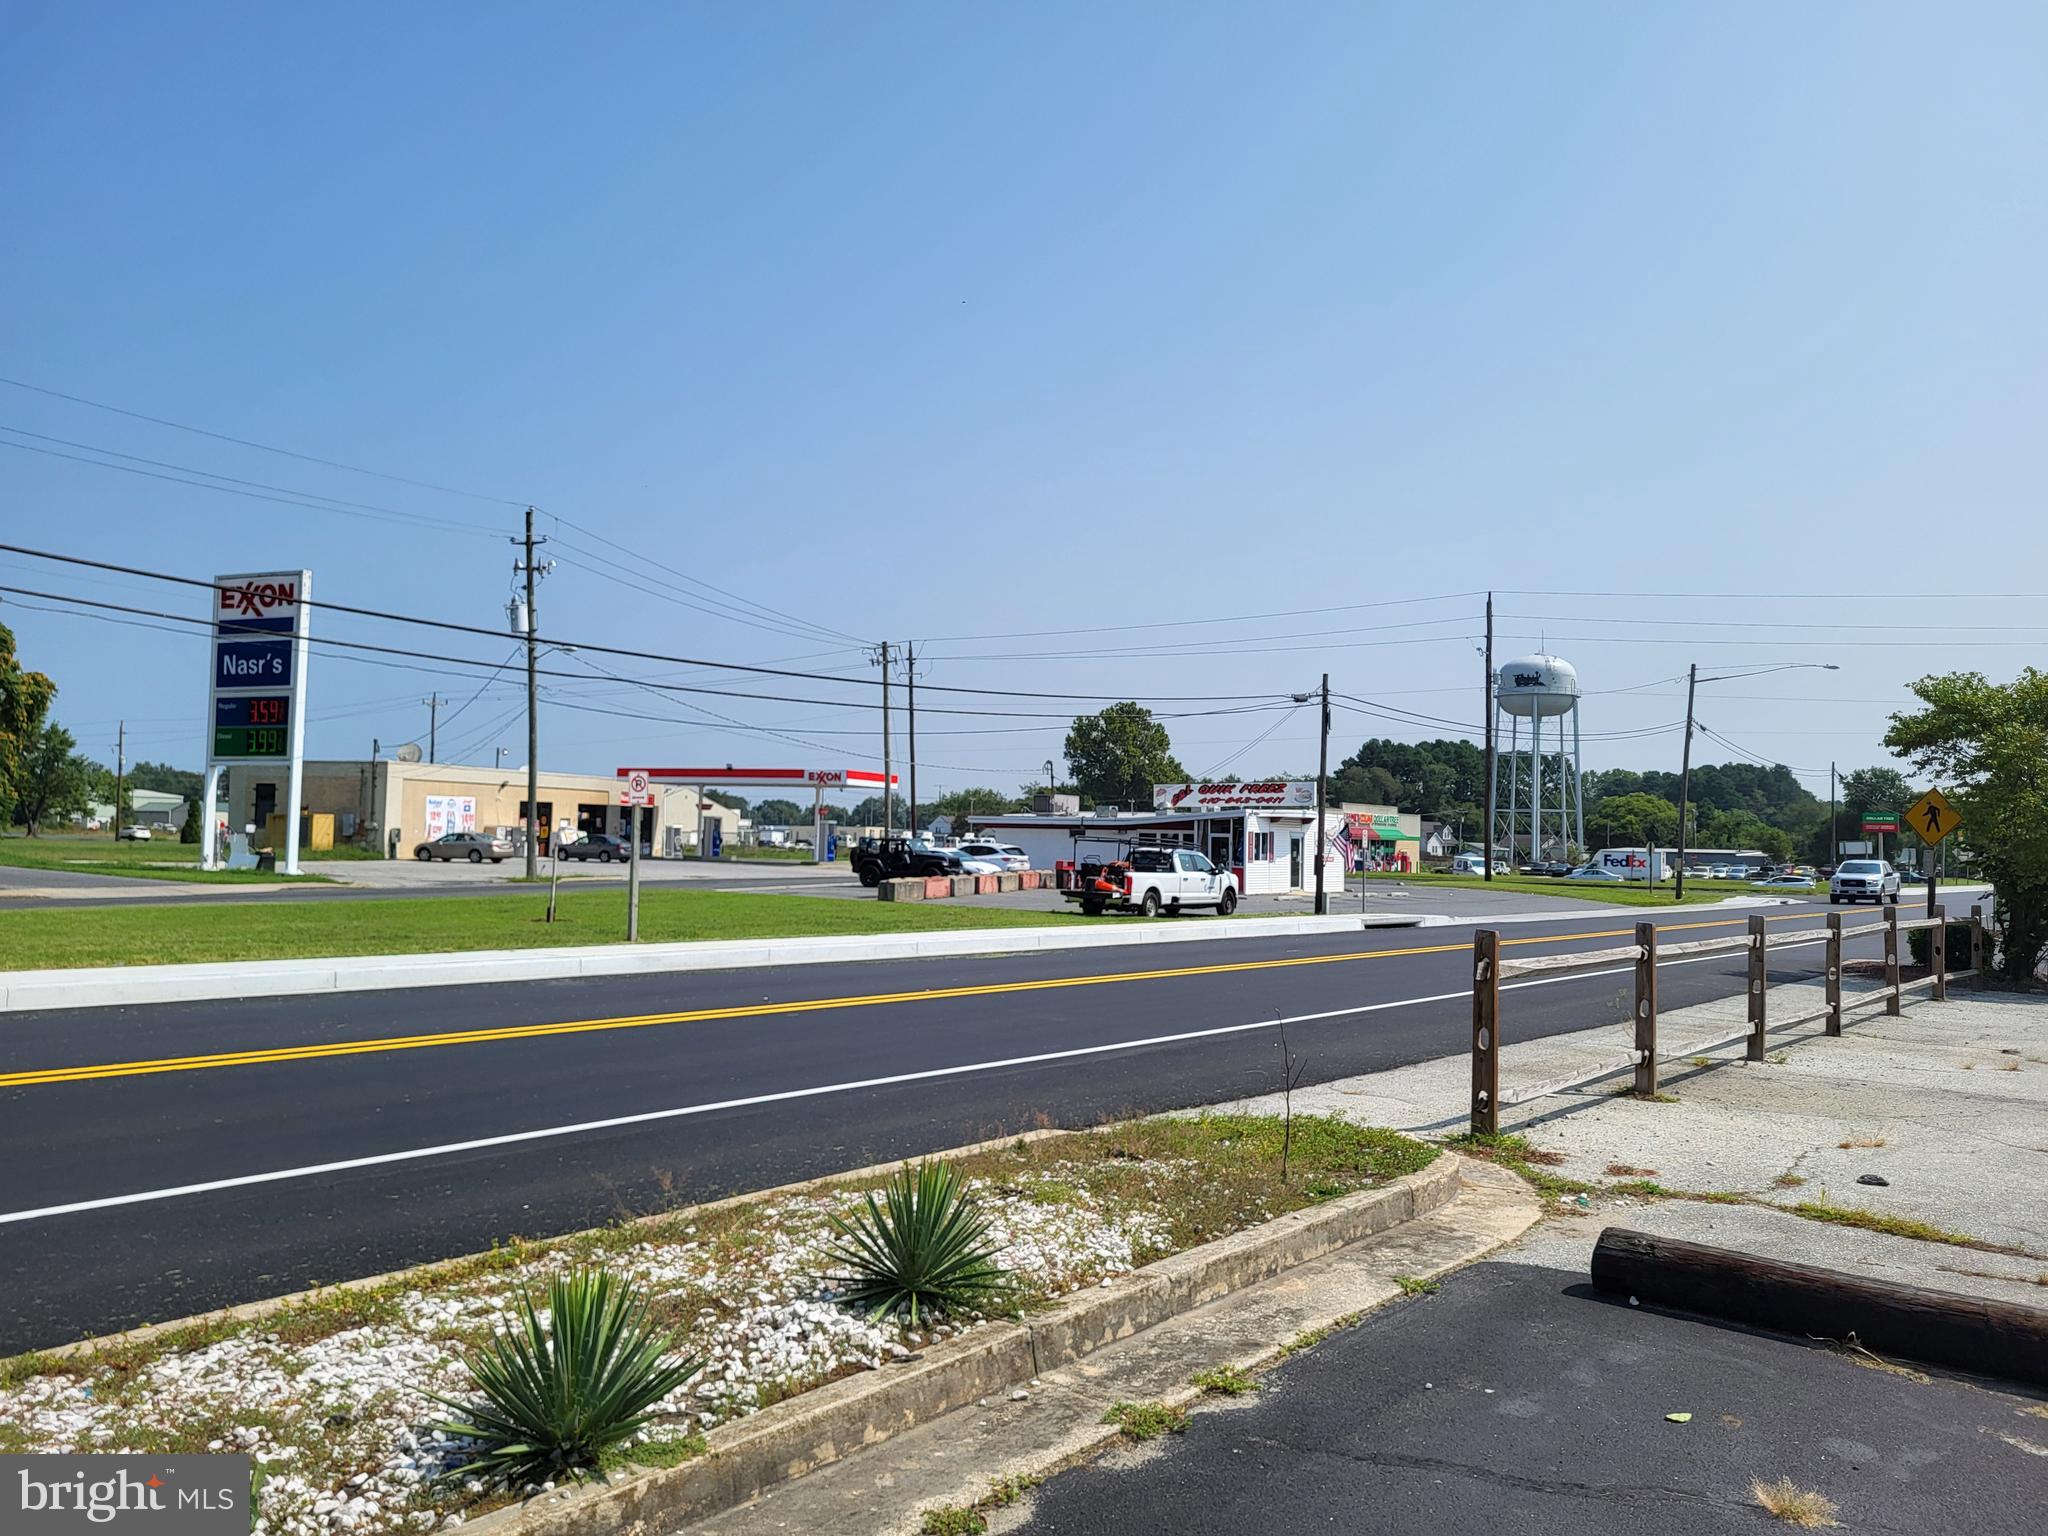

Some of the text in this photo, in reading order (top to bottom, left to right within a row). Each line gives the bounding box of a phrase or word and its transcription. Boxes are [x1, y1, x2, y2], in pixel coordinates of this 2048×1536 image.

[220, 581, 294, 617] EXXON
[223, 653, 283, 675] Nasr's
[808, 771, 840, 785] EXXON
[1603, 854, 1647, 869] FedEx
